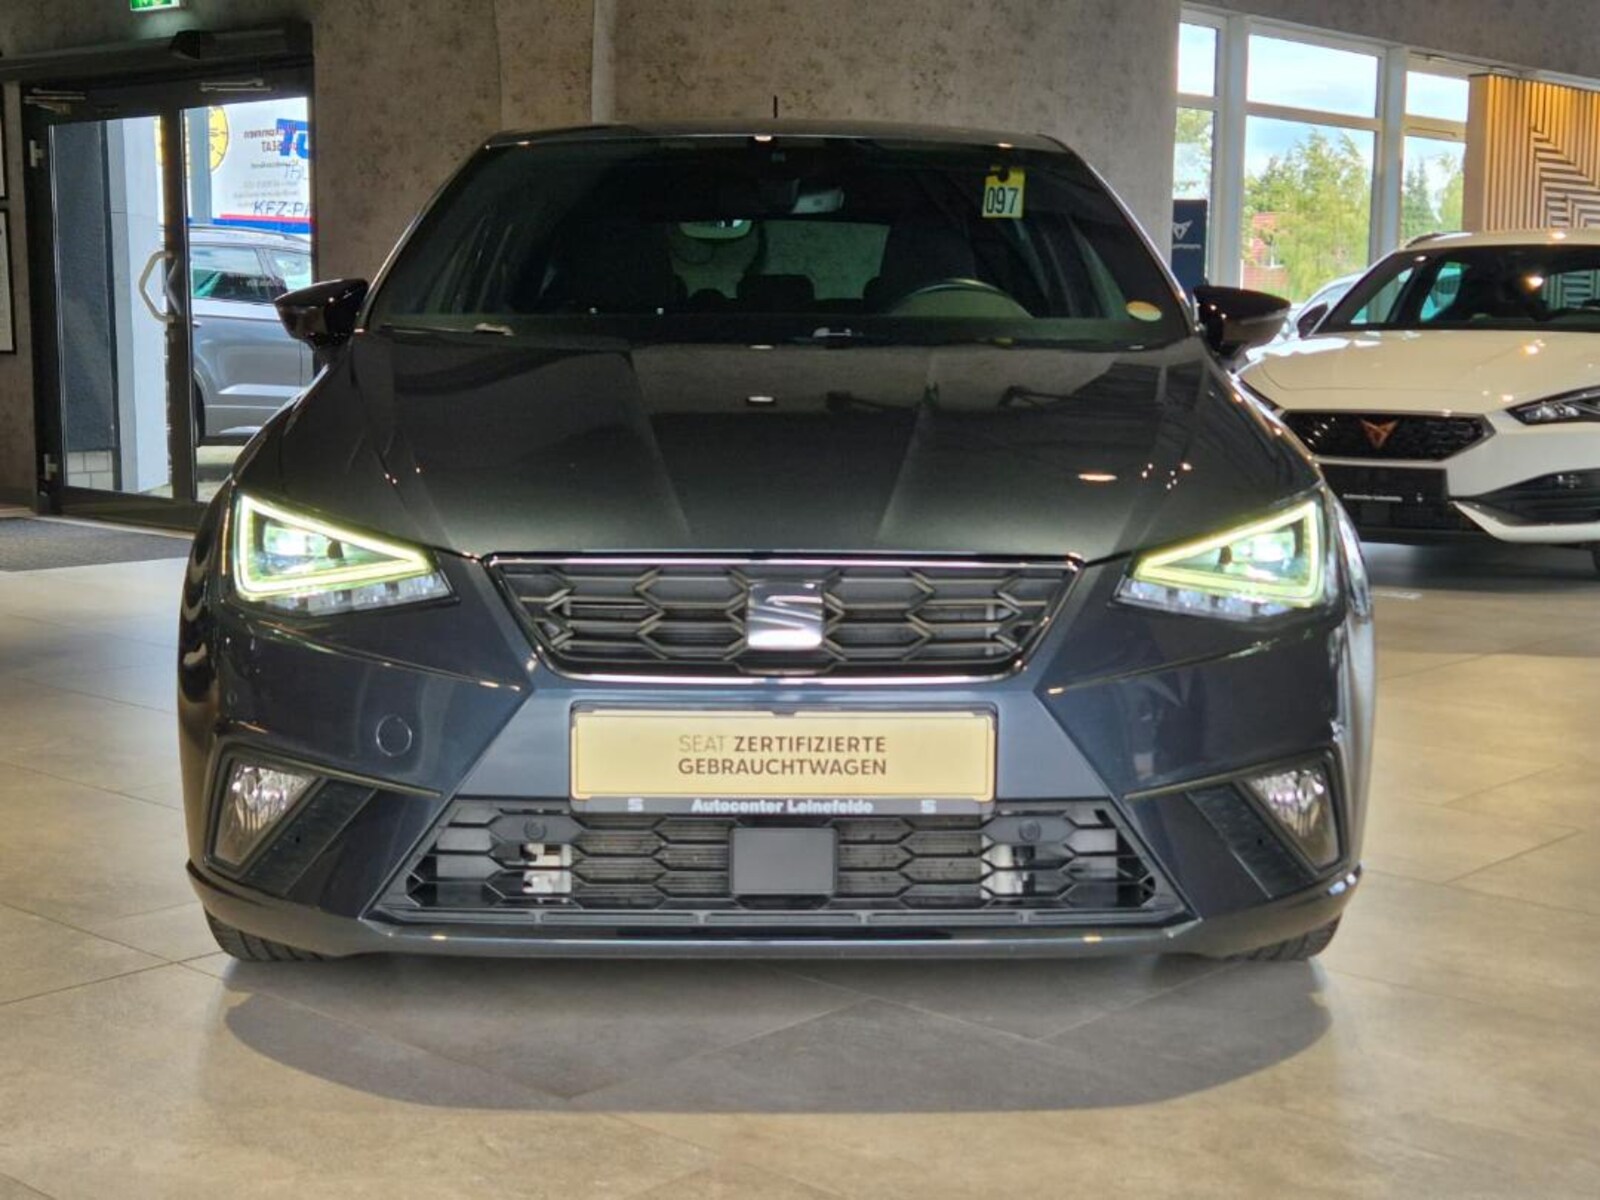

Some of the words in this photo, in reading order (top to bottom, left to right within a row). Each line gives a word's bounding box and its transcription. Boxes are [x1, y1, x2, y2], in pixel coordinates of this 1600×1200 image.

[986, 187, 1019, 214] 097
[678, 734, 726, 752] SEAT
[733, 735, 887, 753] ZERTIFIZIERTE
[678, 758, 888, 776] GEBRAUCHTWAGEN
[691, 798, 784, 814] Autocenter
[787, 799, 874, 814] Leinefelde
